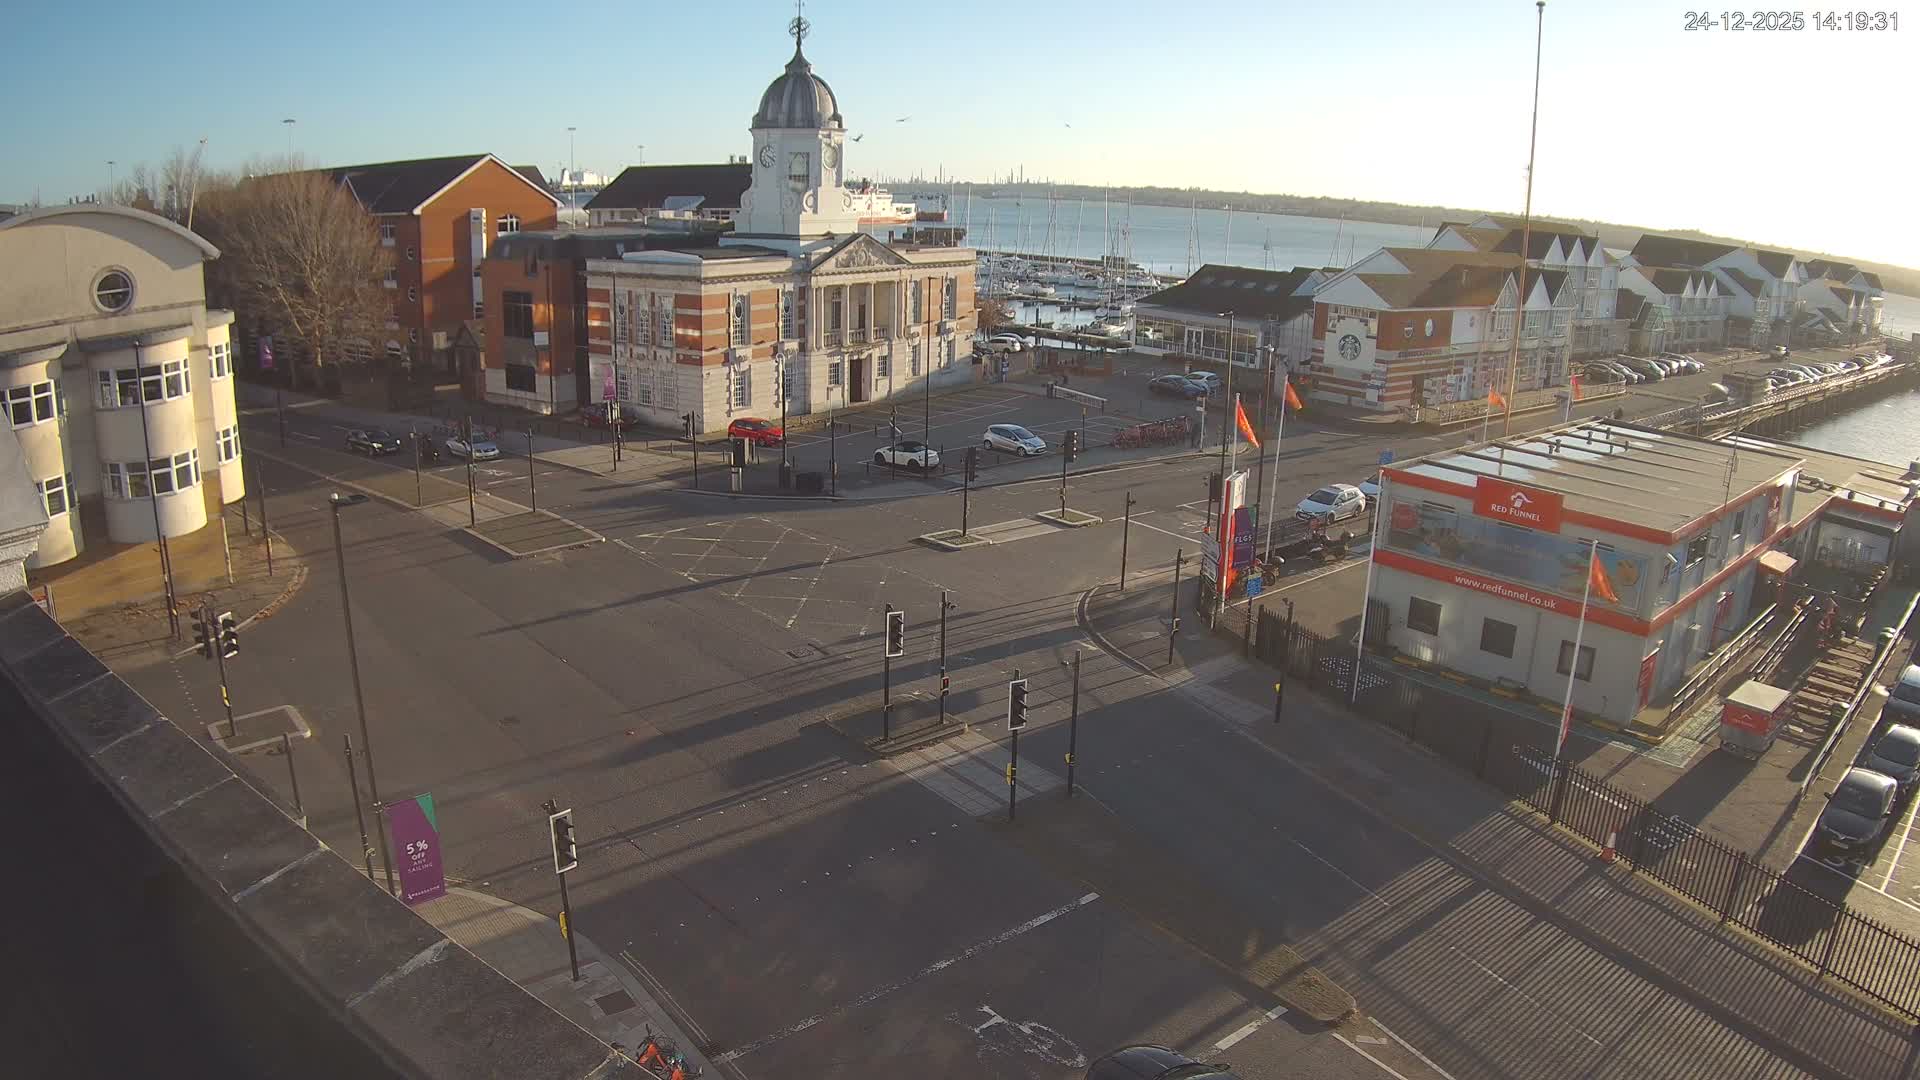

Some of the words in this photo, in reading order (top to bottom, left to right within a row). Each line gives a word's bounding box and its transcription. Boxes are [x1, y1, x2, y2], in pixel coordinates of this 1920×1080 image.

[1491, 503, 1507, 512] RED
[1509, 508, 1541, 521] FUNNEL
[1455, 575, 1556, 609] www.redfunnel.co.uk
